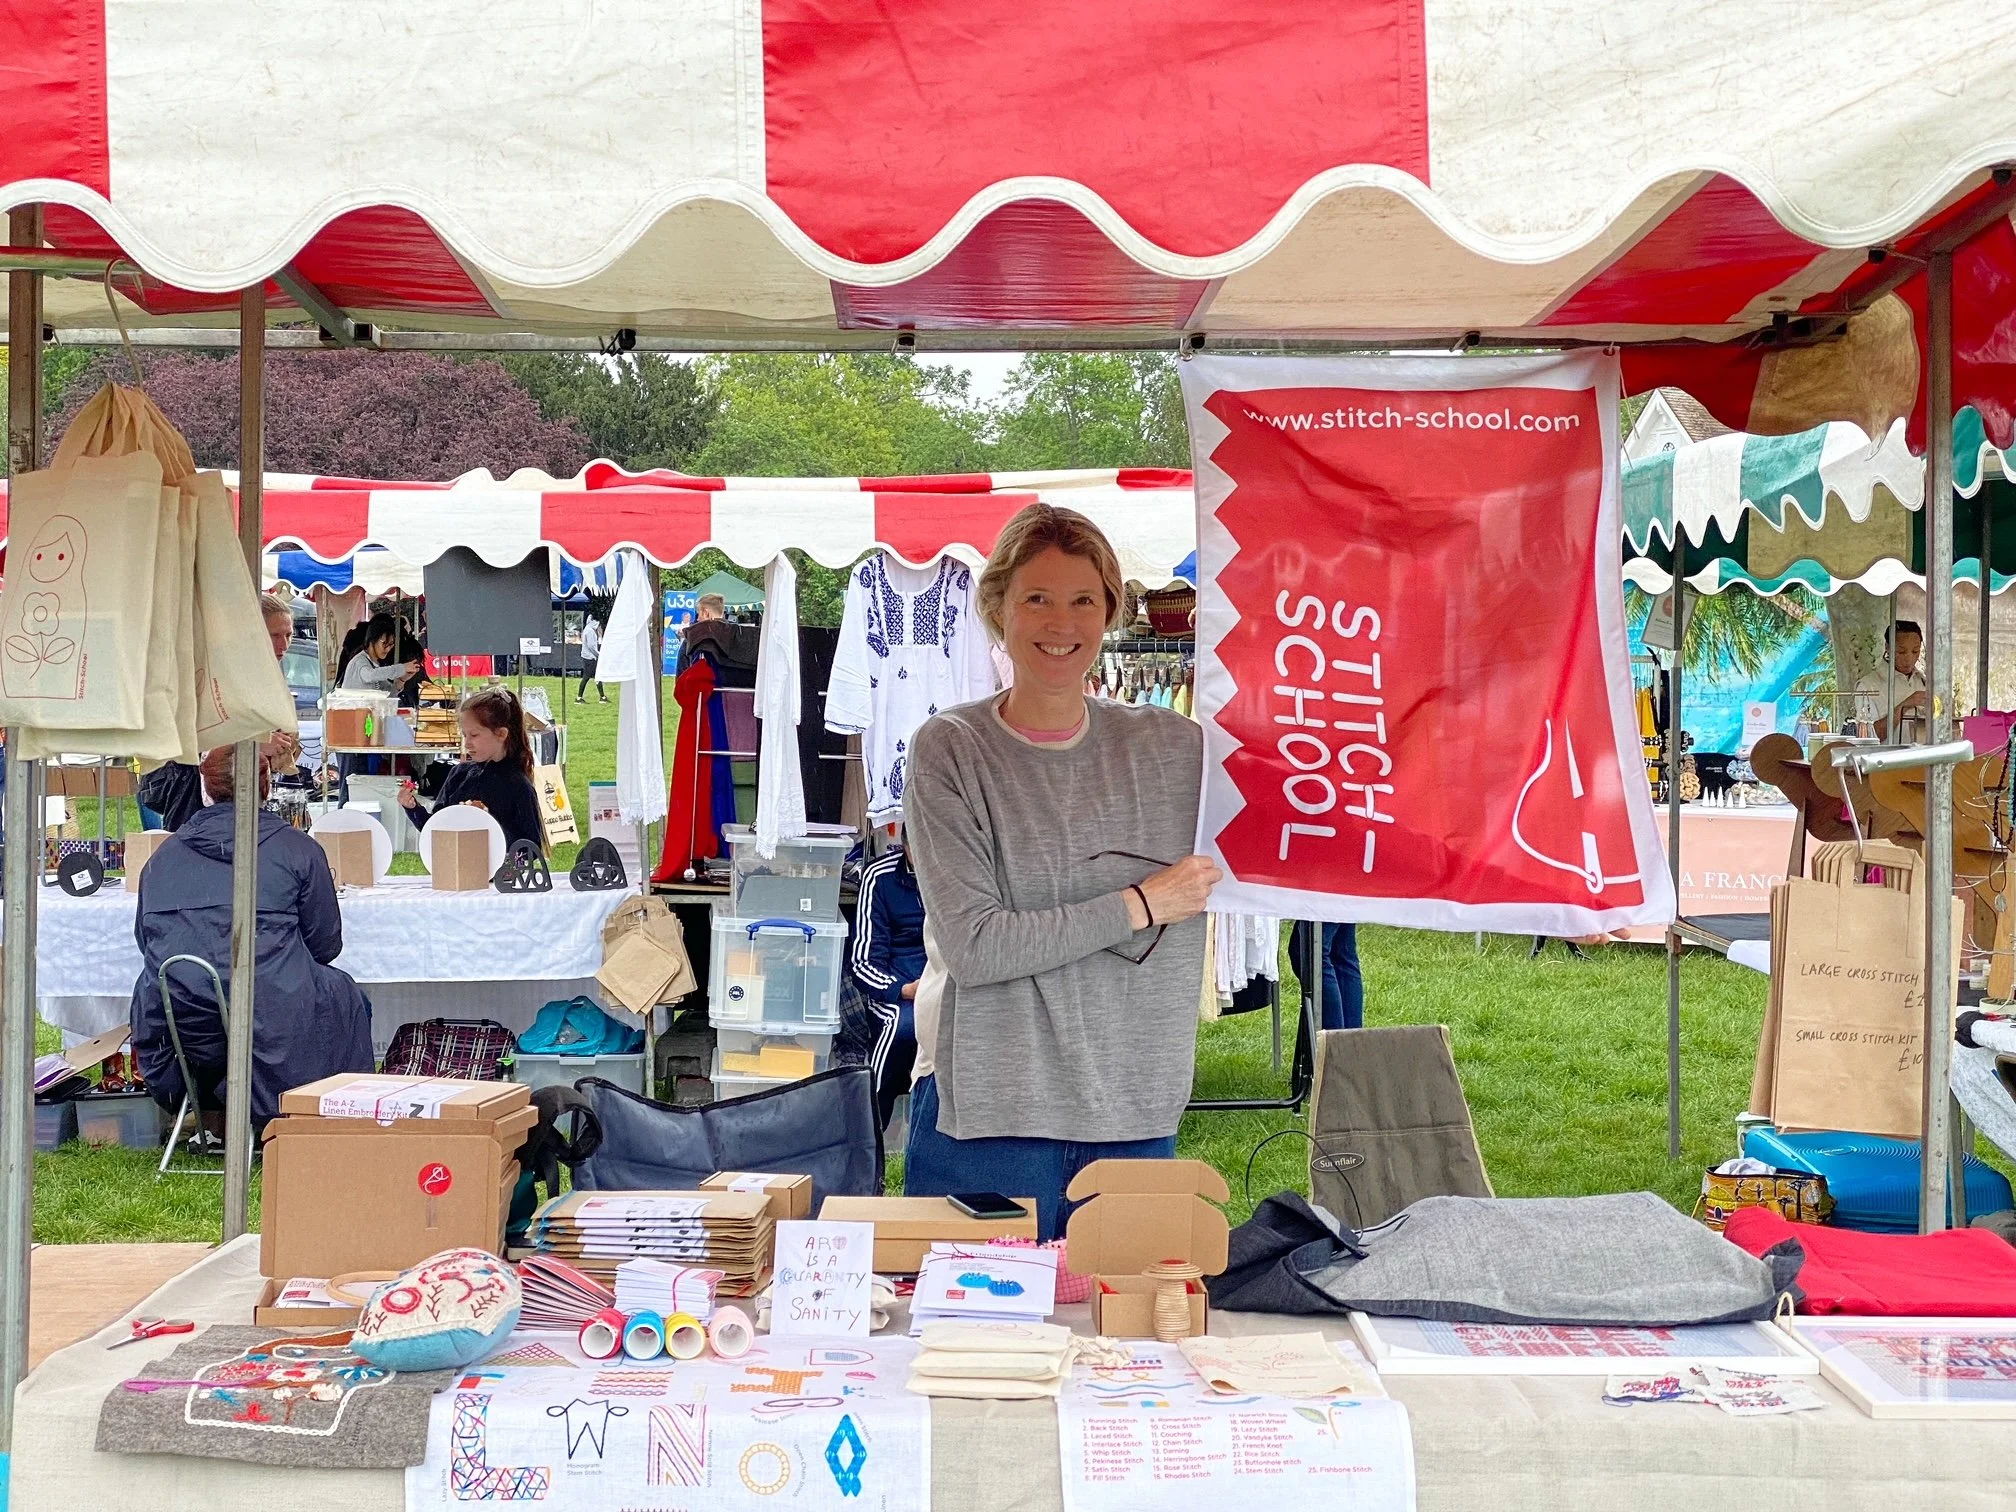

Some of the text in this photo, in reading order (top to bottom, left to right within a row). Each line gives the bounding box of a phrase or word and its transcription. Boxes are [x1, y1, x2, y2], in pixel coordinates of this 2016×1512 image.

[1243, 406, 1580, 433] www.stitch-school.com
[667, 594, 695, 608] u3a
[441, 659, 470, 667] VOLA
[1276, 590, 1337, 861] SCHOOL
[1703, 871, 1788, 890] FRANC
[1800, 963, 1920, 987] LARGE CROSS STITCH
[1796, 1029, 1918, 1045] SMALL CROSS STITCH KIT
[324, 1098, 339, 1107] The
[323, 1106, 346, 1115] Linen
[348, 1108, 394, 1119] Embroery
[827, 1254, 837, 1267] A
[779, 1267, 866, 1289] GUARANTY
[1244, 1434, 1272, 1442] Vandyke
[1164, 1472, 1190, 1480] Rhodes
